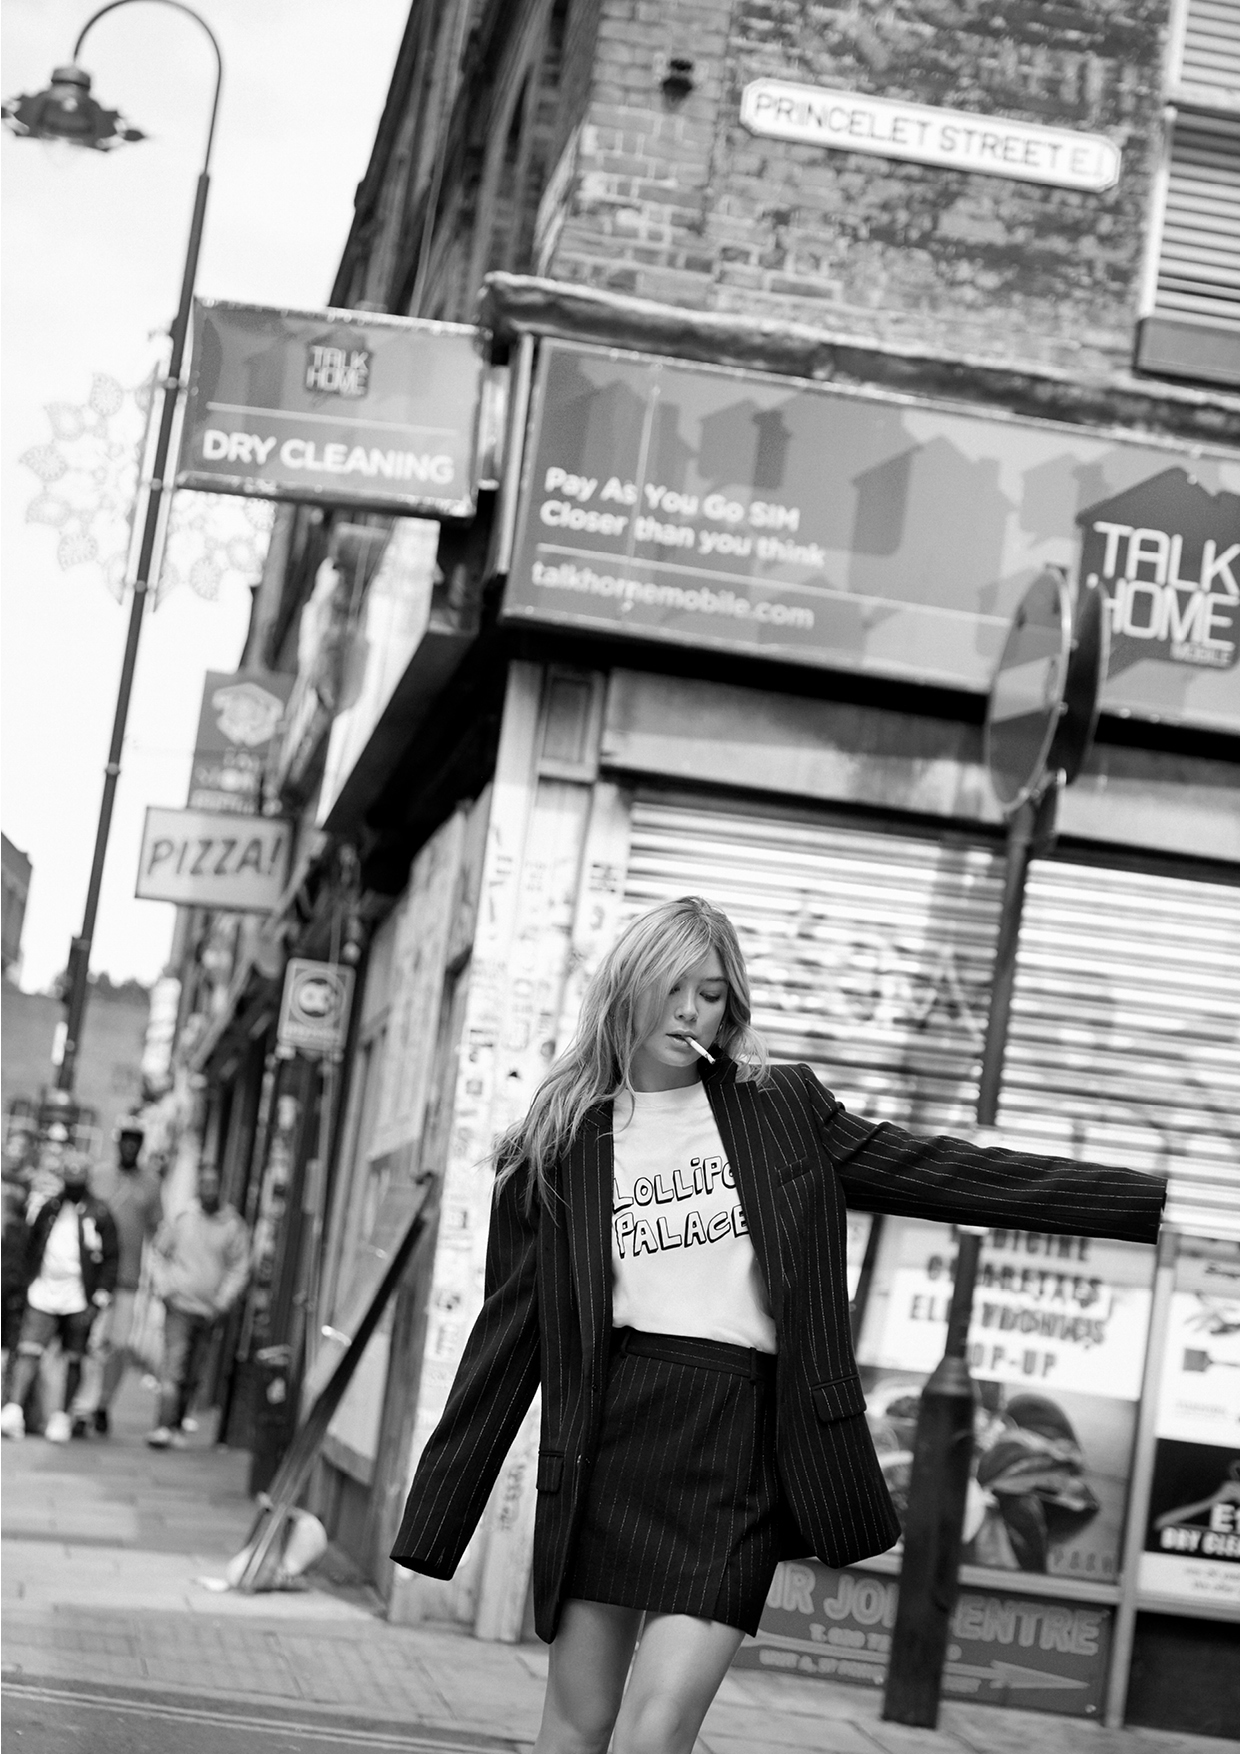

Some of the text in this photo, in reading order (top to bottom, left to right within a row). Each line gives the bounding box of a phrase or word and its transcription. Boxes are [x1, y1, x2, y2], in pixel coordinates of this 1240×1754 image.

[754, 93, 931, 146] PRINCELET
[939, 125, 1063, 168] STREET
[306, 365, 369, 396] HOME
[311, 345, 369, 370] TALK
[202, 429, 455, 485] DRY CLEANING
[544, 466, 799, 532] Pay As You Go SIM
[540, 499, 825, 568] Closer than you think
[1093, 521, 1240, 596] TALK
[532, 560, 814, 630] talkhomemobile.com
[147, 836, 282, 876] PIZZA!
[615, 1203, 750, 1260] PALACE
[950, 1595, 1100, 1657] ENTRE
